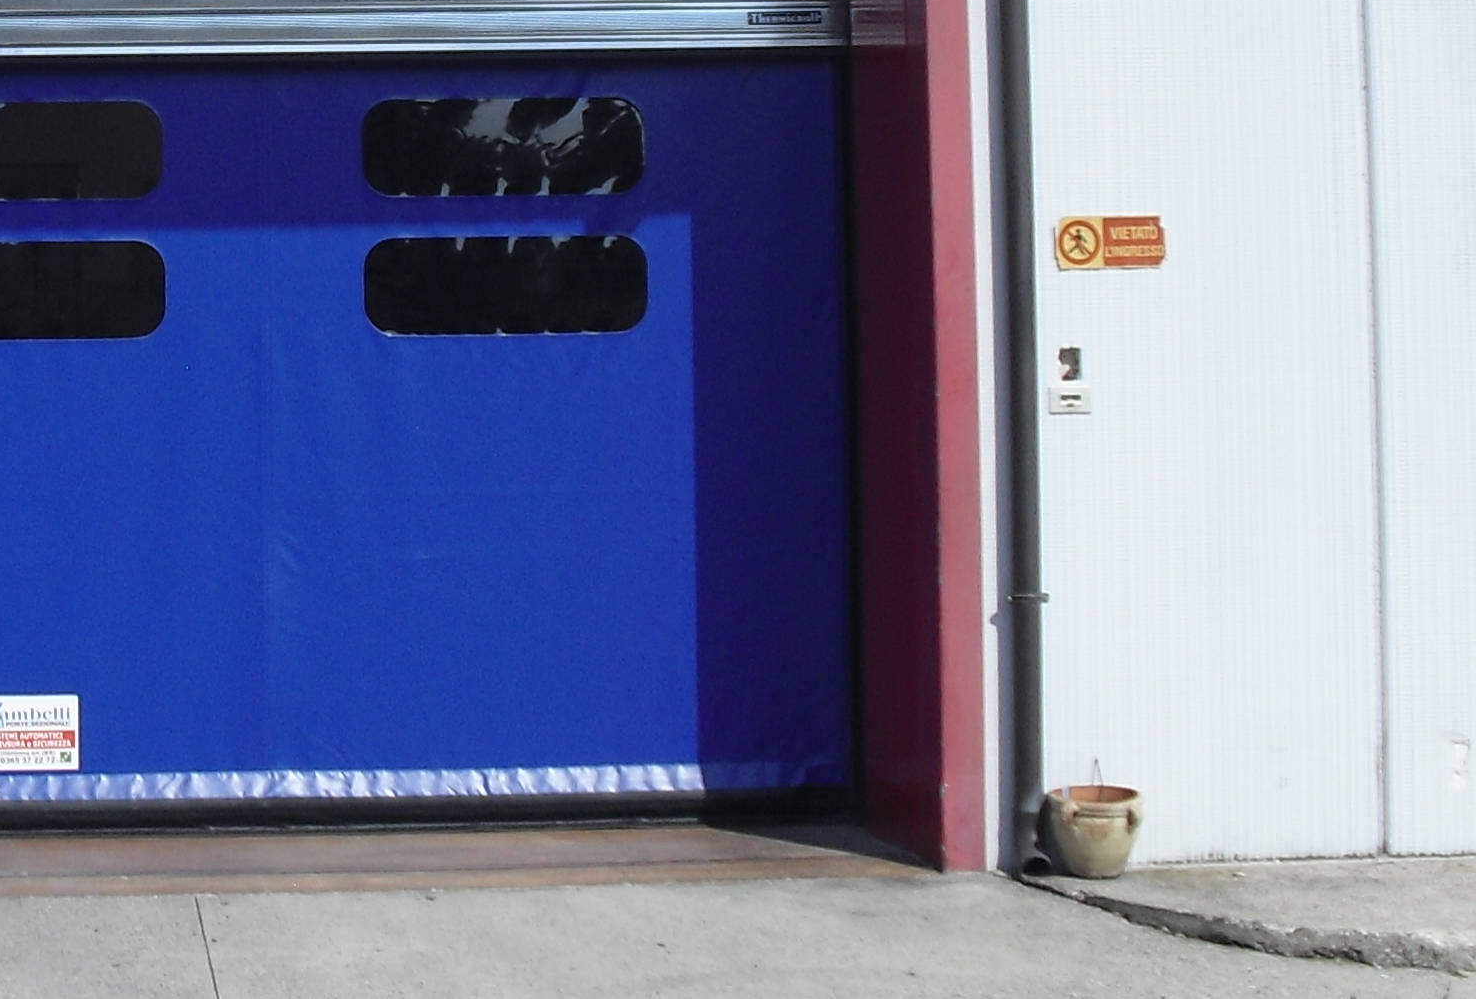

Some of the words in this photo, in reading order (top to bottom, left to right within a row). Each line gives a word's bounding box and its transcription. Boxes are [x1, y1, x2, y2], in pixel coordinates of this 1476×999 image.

[1110, 226, 1159, 240] VIETATO
[20, 732, 64, 740] AUTOMATICI
[32, 740, 72, 749] SICUREZZA
